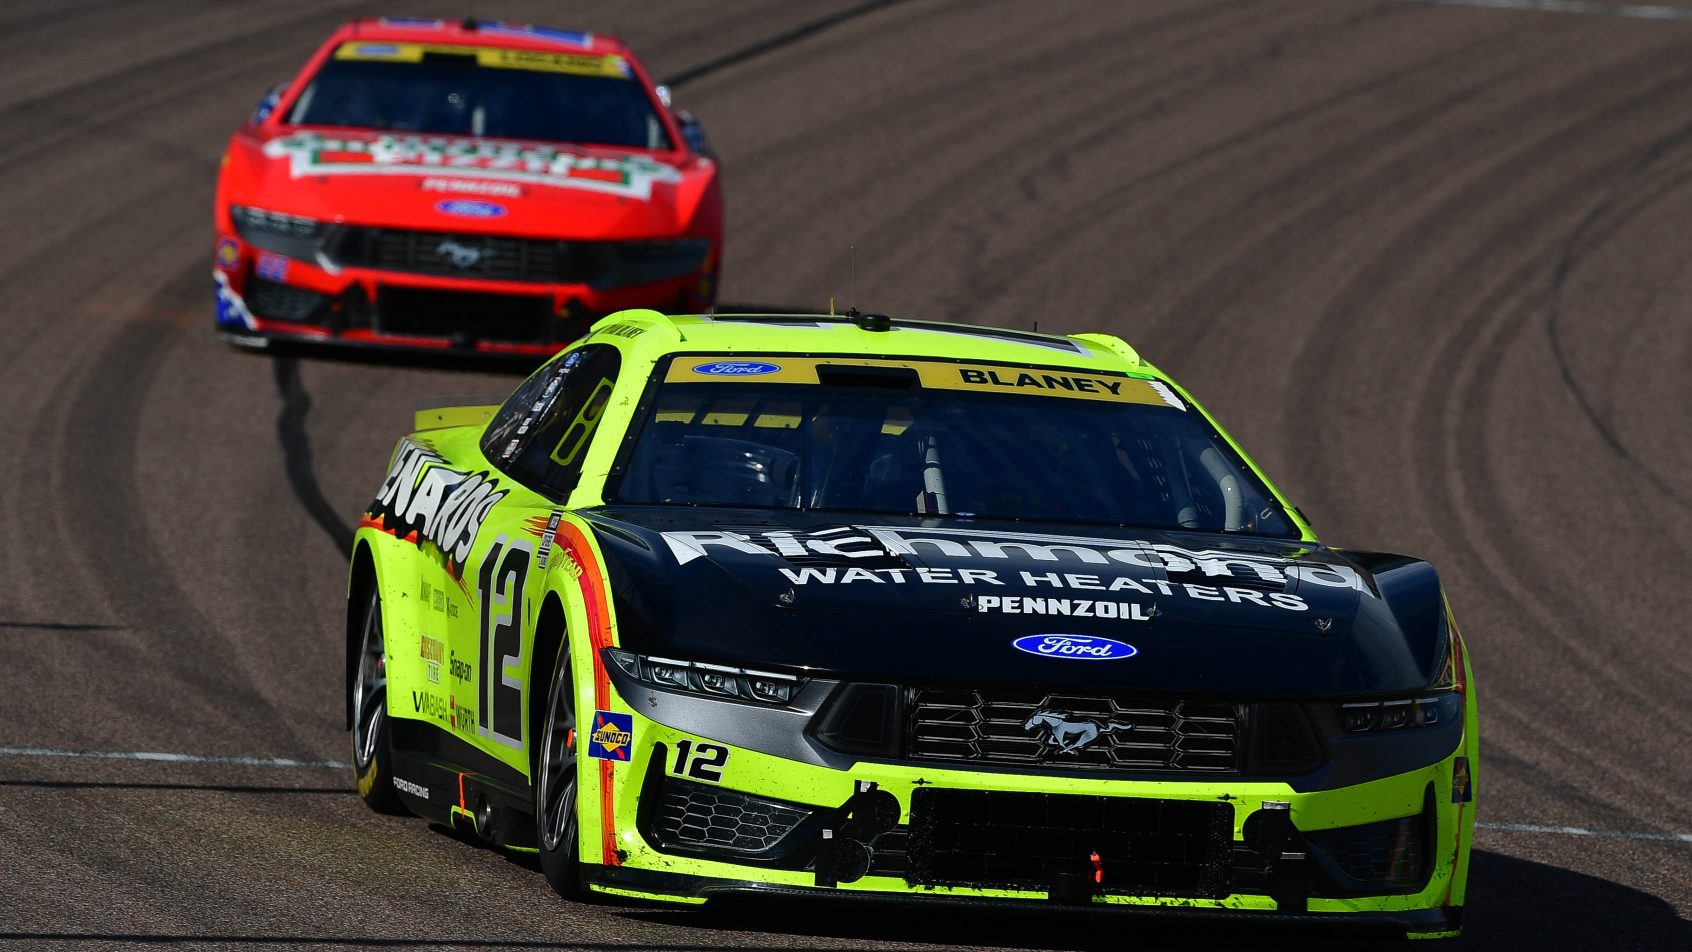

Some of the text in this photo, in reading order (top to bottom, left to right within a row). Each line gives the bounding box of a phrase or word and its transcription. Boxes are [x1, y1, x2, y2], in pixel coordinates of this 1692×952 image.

[708, 361, 766, 374] Ford
[960, 368, 1123, 396] BLANEY
[659, 525, 1376, 599] Richmond
[778, 567, 1309, 611] WATER HEATERS
[978, 594, 1150, 621] PENNZOIL
[478, 534, 532, 752] 12
[1035, 635, 1115, 657] Ford
[412, 690, 448, 721] WABASH
[595, 730, 630, 745] SUNOCO
[672, 738, 730, 784] 12
[392, 776, 429, 799] FORD RACING
